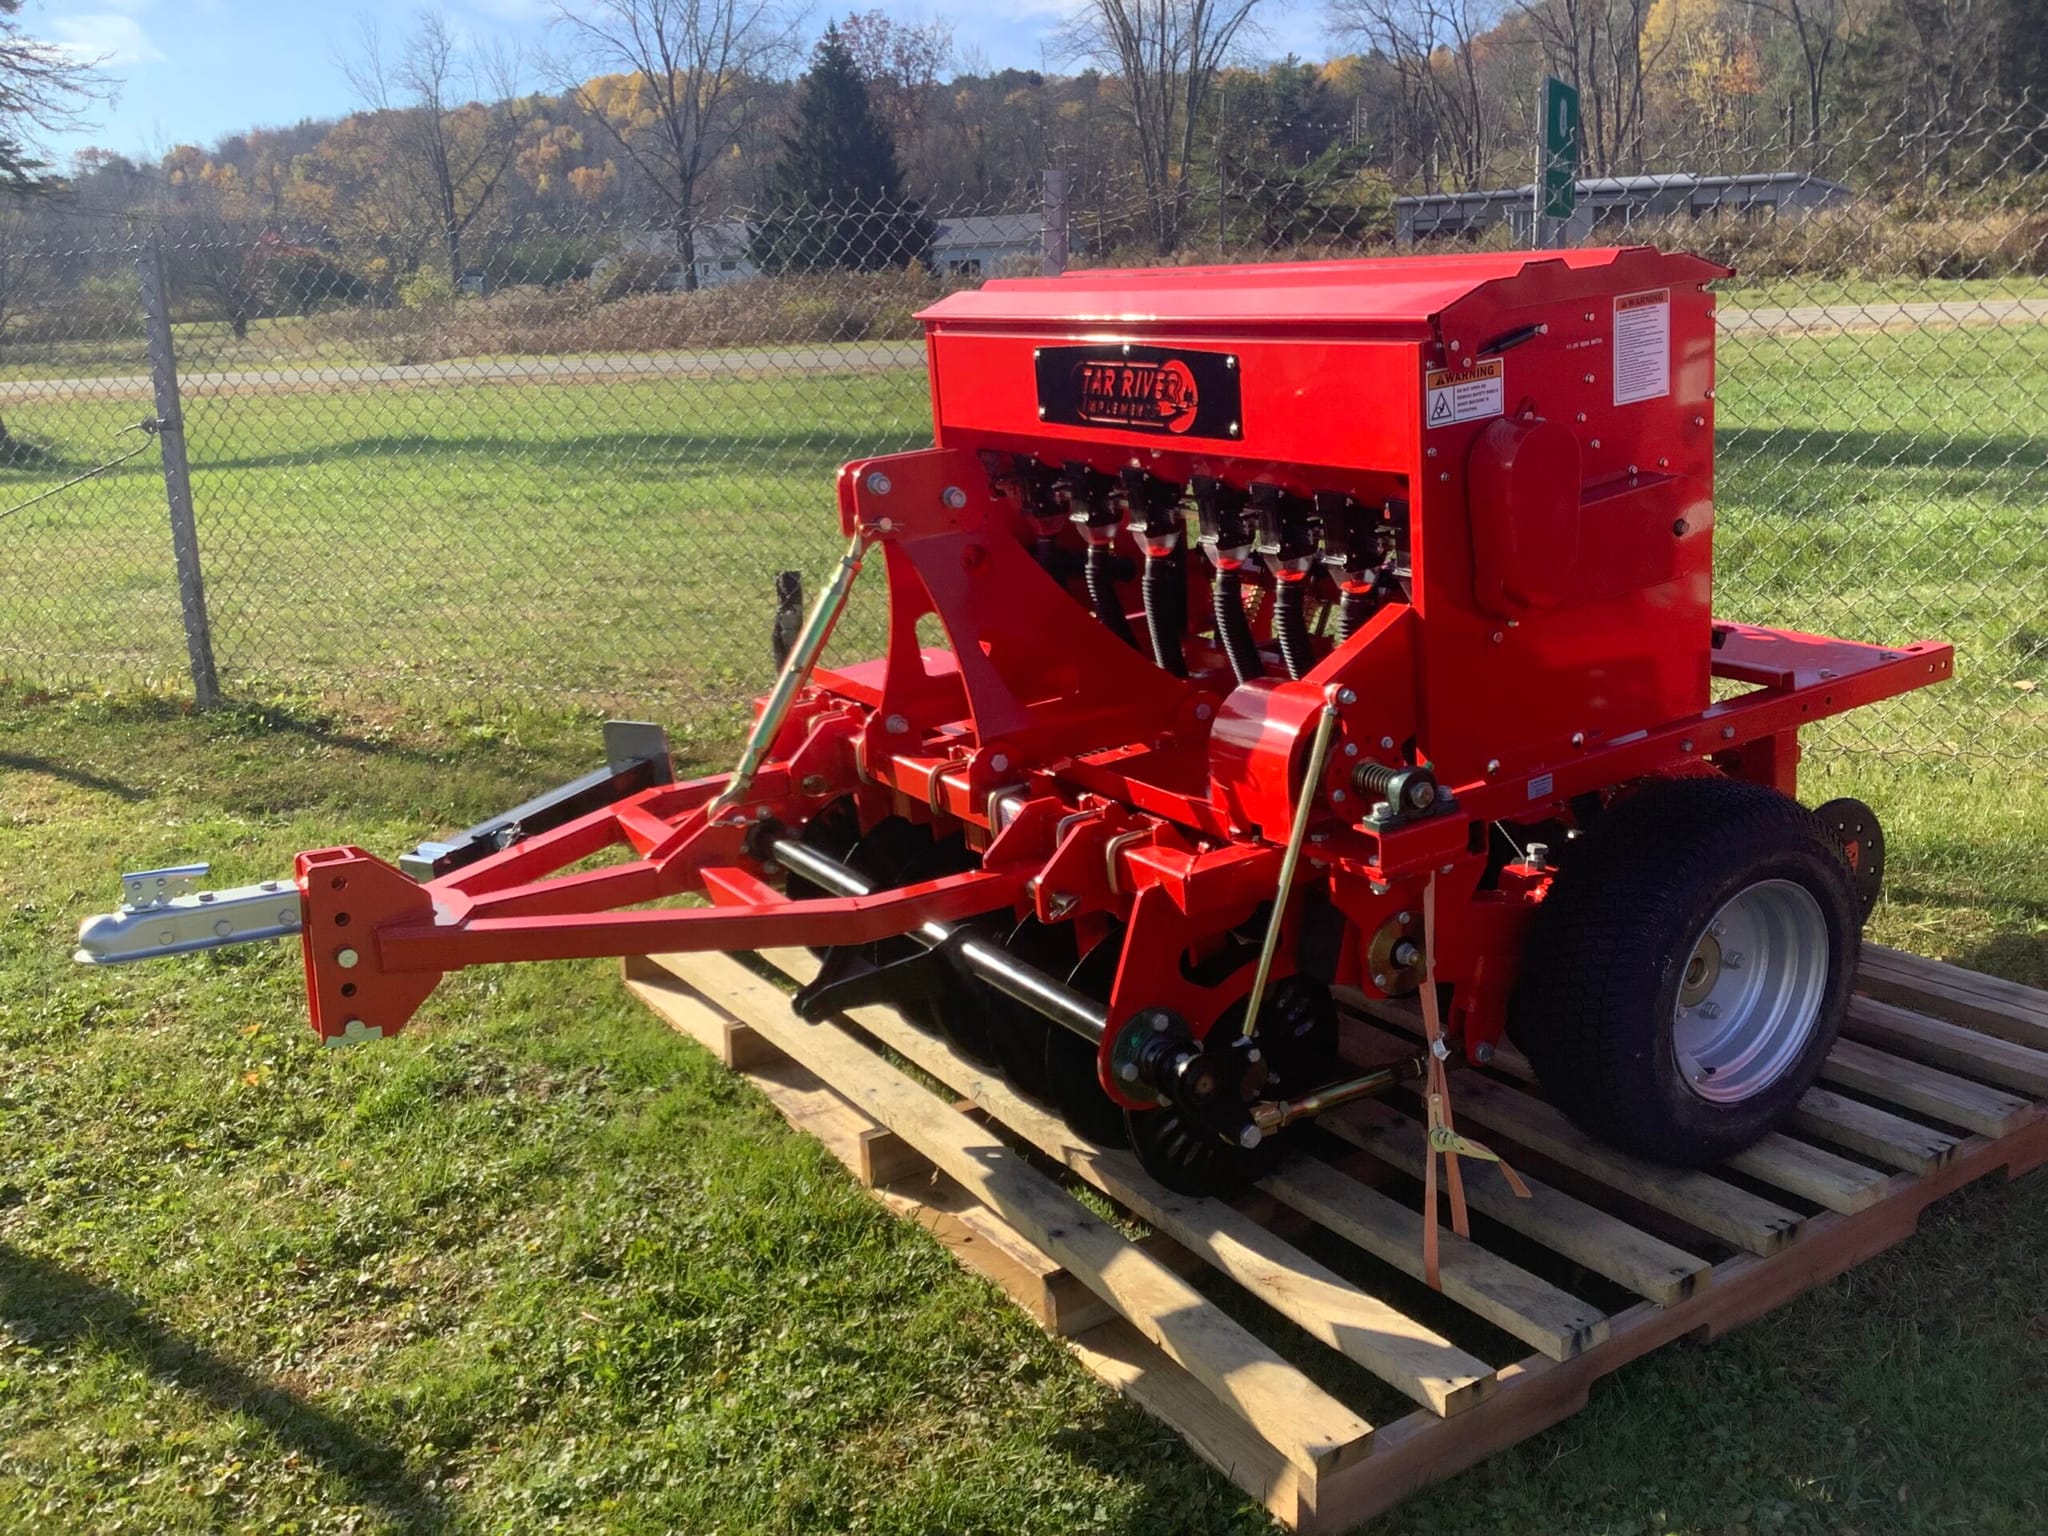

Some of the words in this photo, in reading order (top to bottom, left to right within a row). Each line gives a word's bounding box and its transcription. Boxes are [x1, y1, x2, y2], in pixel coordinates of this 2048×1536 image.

[1628, 293, 1664, 307] WARNING
[1445, 365, 1494, 384] WARNING
[1083, 368, 1115, 398] TAR
[1121, 369, 1181, 403] RIVER
